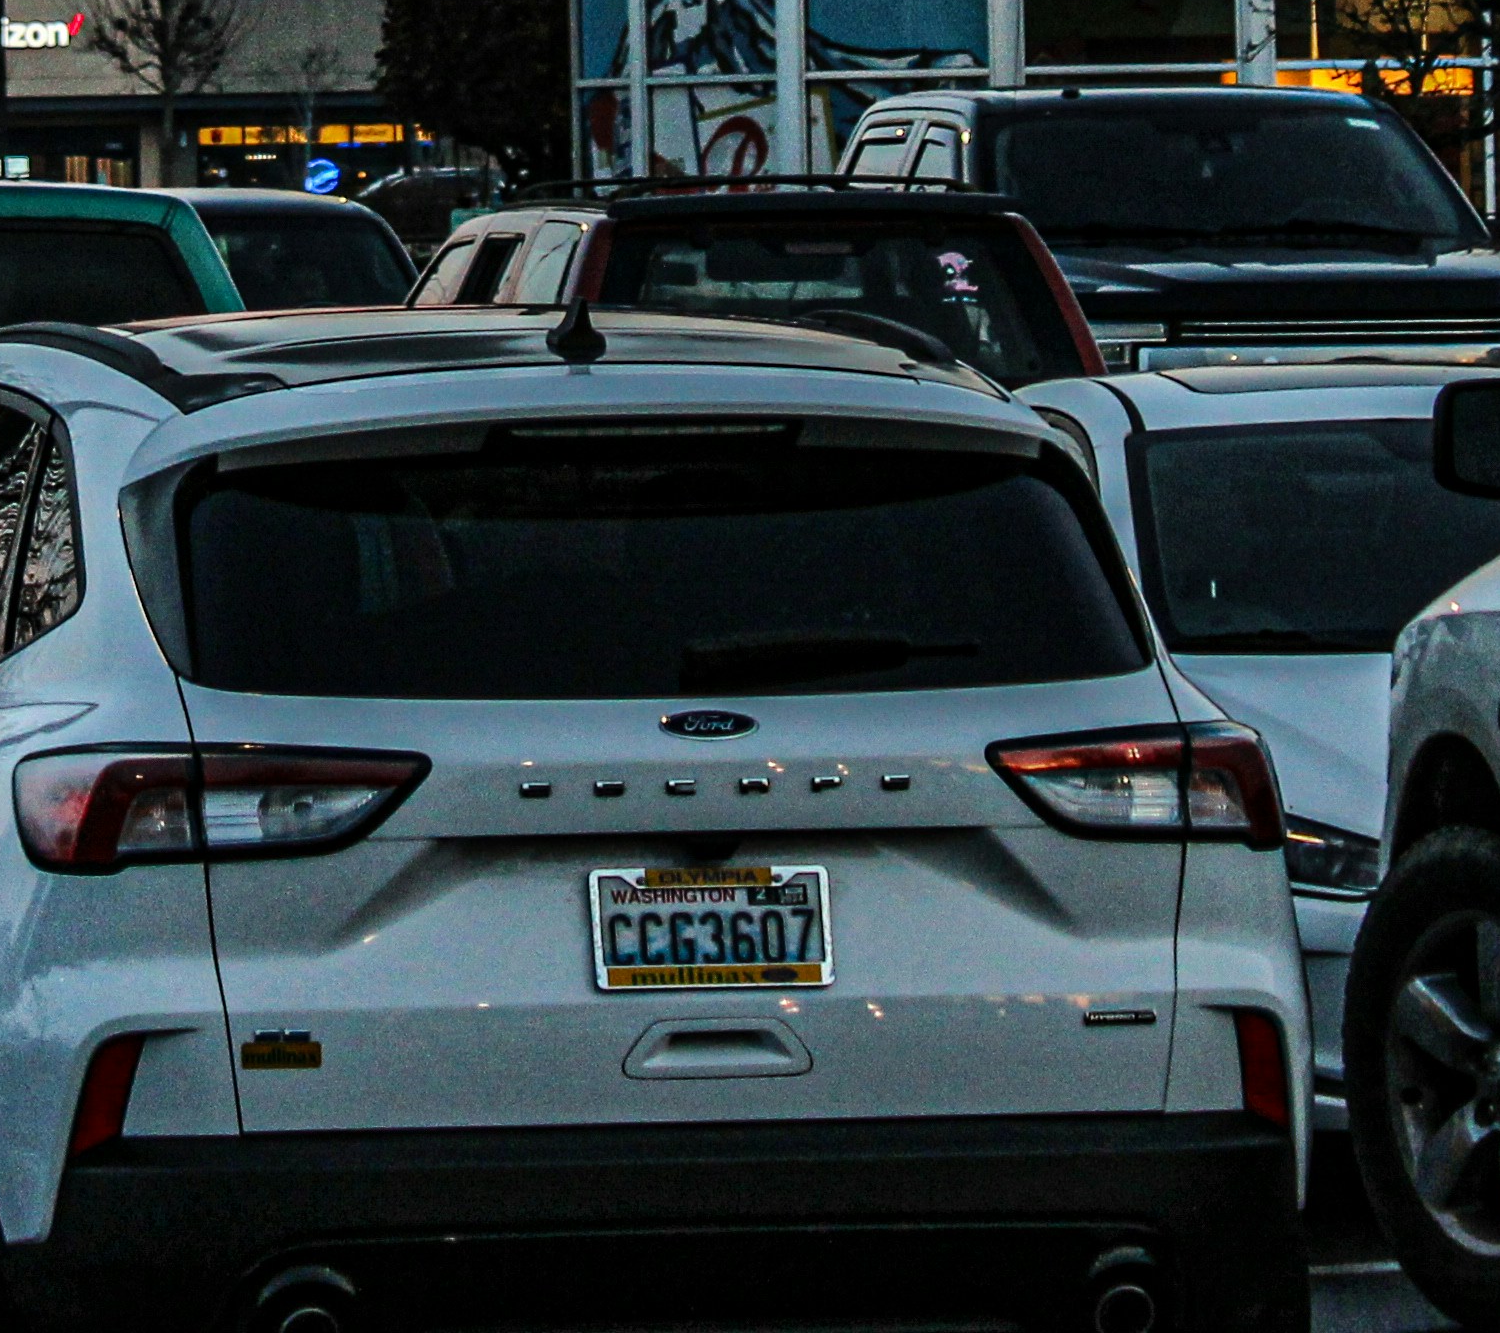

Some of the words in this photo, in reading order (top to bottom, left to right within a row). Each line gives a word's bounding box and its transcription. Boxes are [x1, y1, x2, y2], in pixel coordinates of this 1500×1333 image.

[683, 713, 736, 732] Ford
[657, 870, 758, 884] OLYMPIA
[611, 886, 737, 905] WASHINGTON
[608, 907, 815, 967] CCG3607
[630, 966, 756, 985] mullinax
